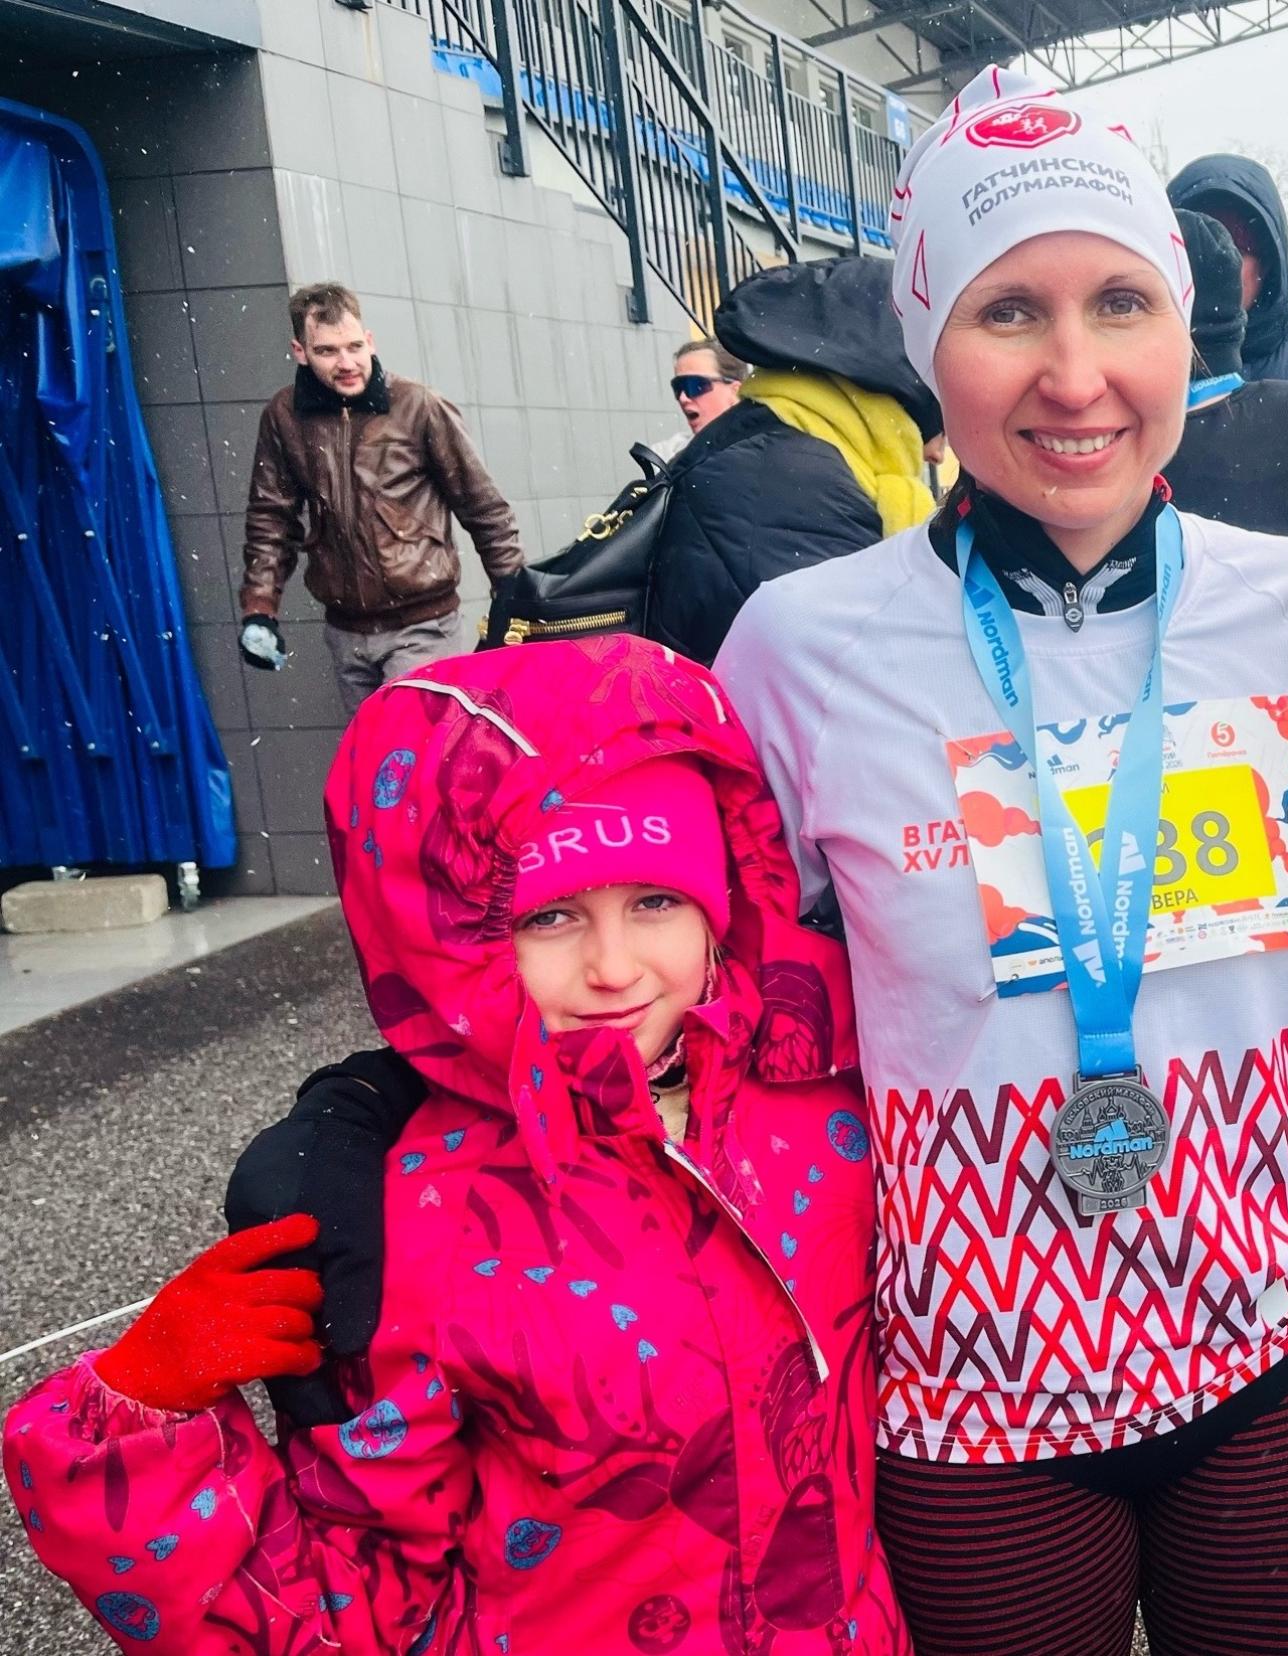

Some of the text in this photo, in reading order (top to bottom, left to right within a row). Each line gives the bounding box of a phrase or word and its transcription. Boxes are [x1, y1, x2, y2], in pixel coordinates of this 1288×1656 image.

[961, 157, 1132, 210] ГАТЧИНСКИЙ
[968, 175, 1134, 227] ПОЛУМАРАФОН
[977, 610, 1019, 708] Nordman
[1028, 763, 1080, 780] Nman
[517, 814, 672, 874] BRUS
[903, 825, 921, 847] В
[903, 847, 943, 873] XV
[1063, 827, 1097, 936] Nordman
[1151, 887, 1199, 910] ВЕРА
[1069, 1137, 1153, 1159] Nordman
